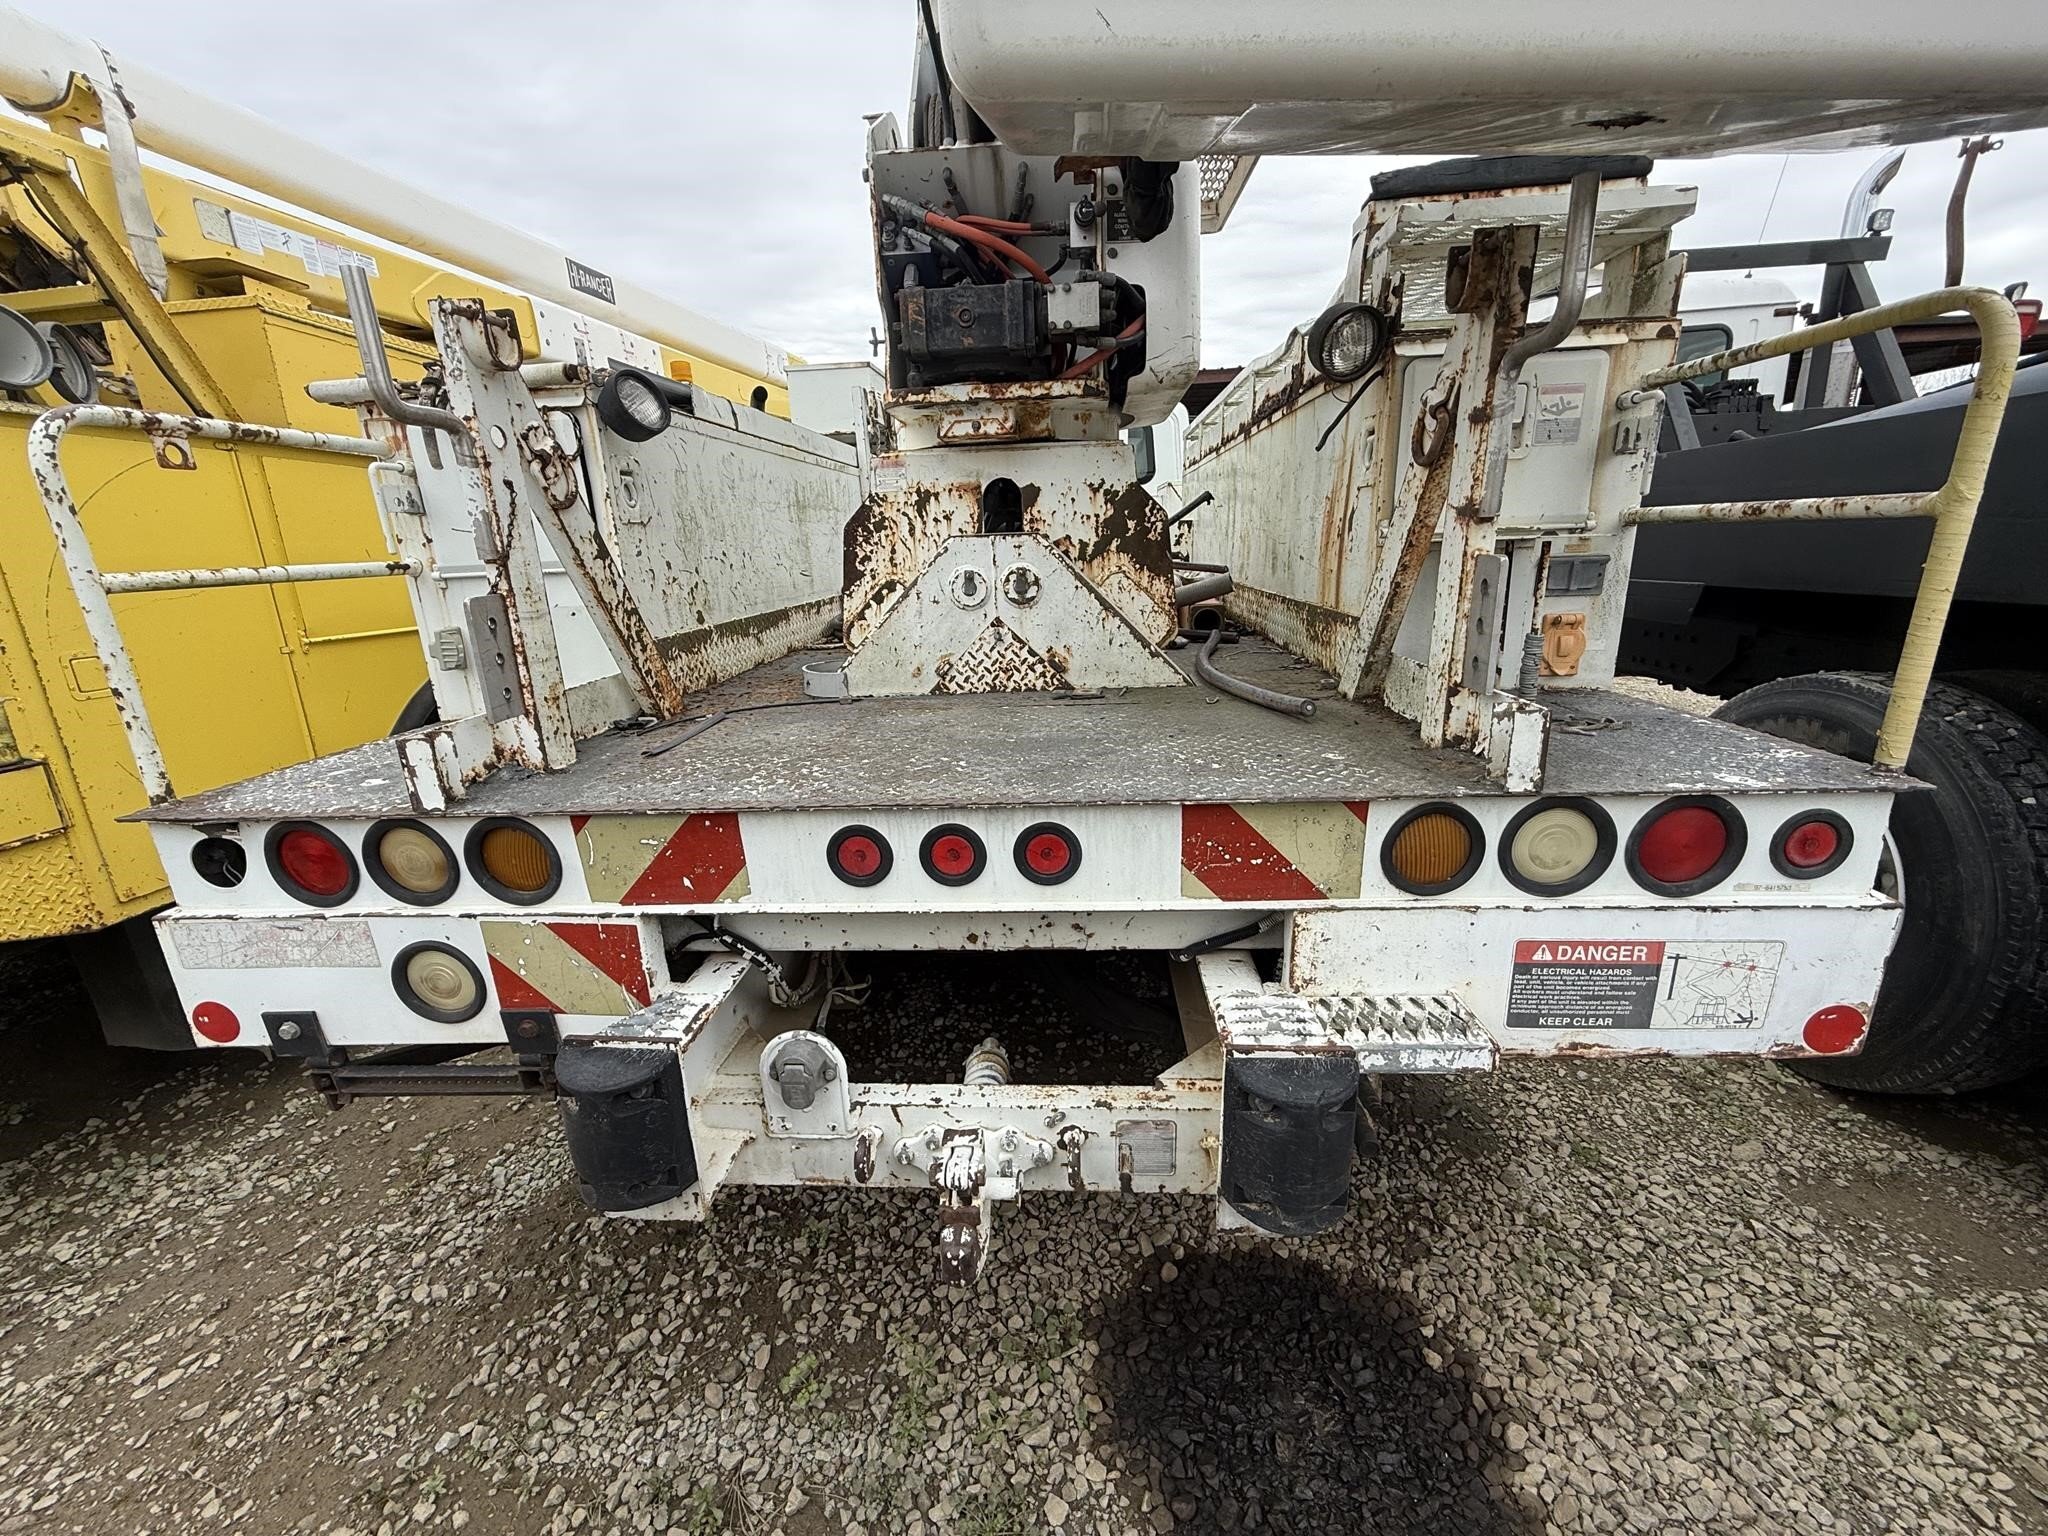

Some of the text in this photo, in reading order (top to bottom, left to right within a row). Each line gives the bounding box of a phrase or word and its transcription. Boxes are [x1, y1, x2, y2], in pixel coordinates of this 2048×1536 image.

[567, 259, 614, 303] HI-RANGER
[1556, 945, 1648, 961] DANGER
[1589, 968, 1633, 976] HAZARDS
[1538, 1017, 1613, 1026] KEEP CLEAR
